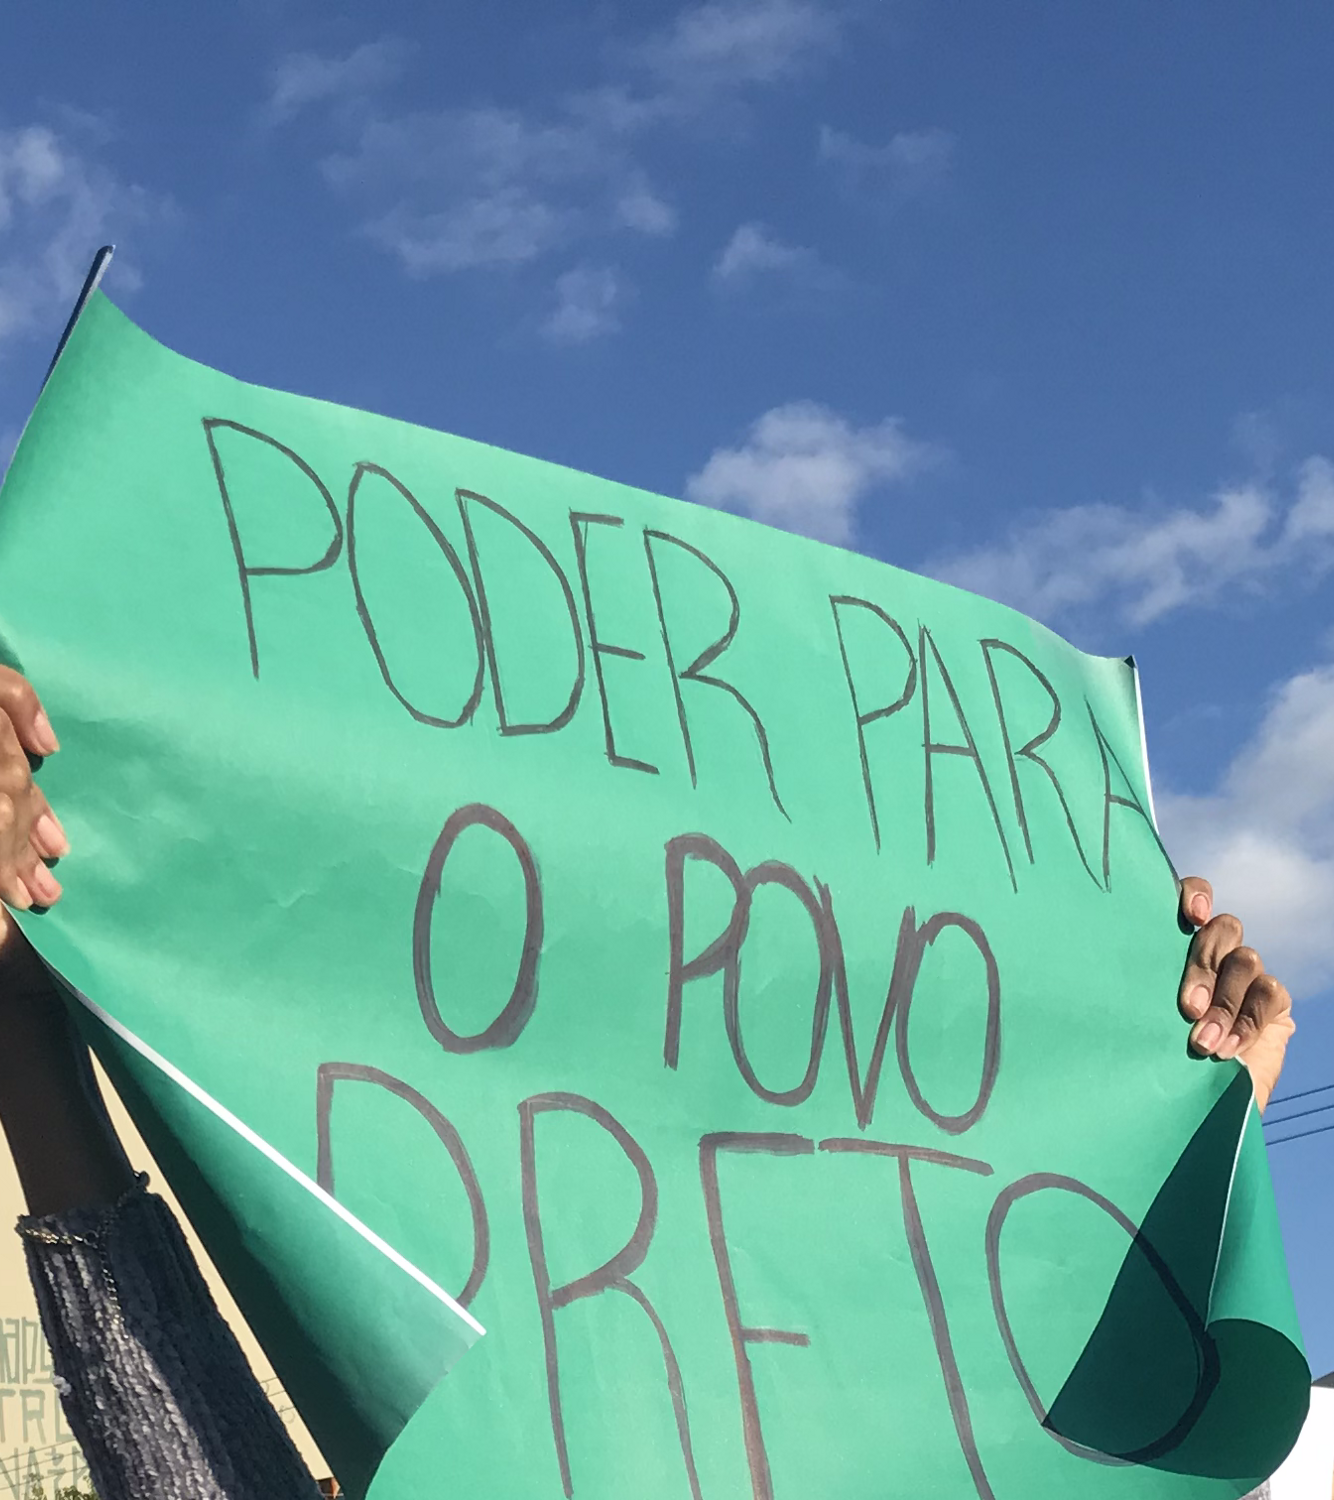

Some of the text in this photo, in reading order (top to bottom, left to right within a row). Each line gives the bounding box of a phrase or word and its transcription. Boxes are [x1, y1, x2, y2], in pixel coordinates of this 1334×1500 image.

[203, 416, 1153, 894] PODER PARA
[413, 803, 1002, 1132] O POVO
